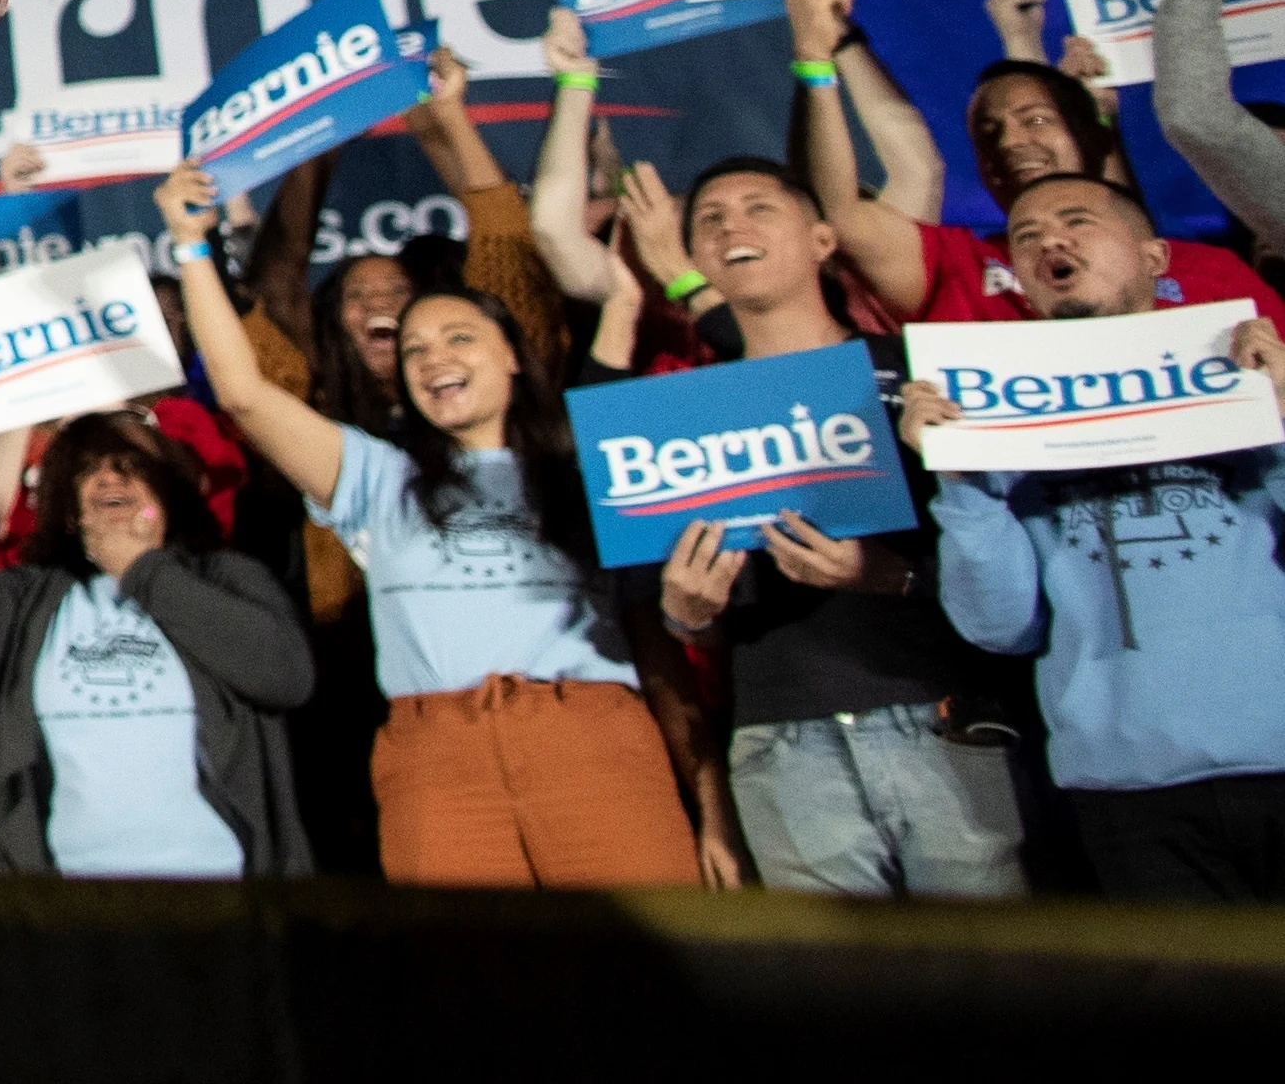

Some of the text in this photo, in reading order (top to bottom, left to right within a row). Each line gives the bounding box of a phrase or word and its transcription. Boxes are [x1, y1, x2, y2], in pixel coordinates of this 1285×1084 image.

[187, 22, 381, 156] Bernie
[938, 350, 1242, 414] Bernie
[598, 401, 874, 498] Bernie
